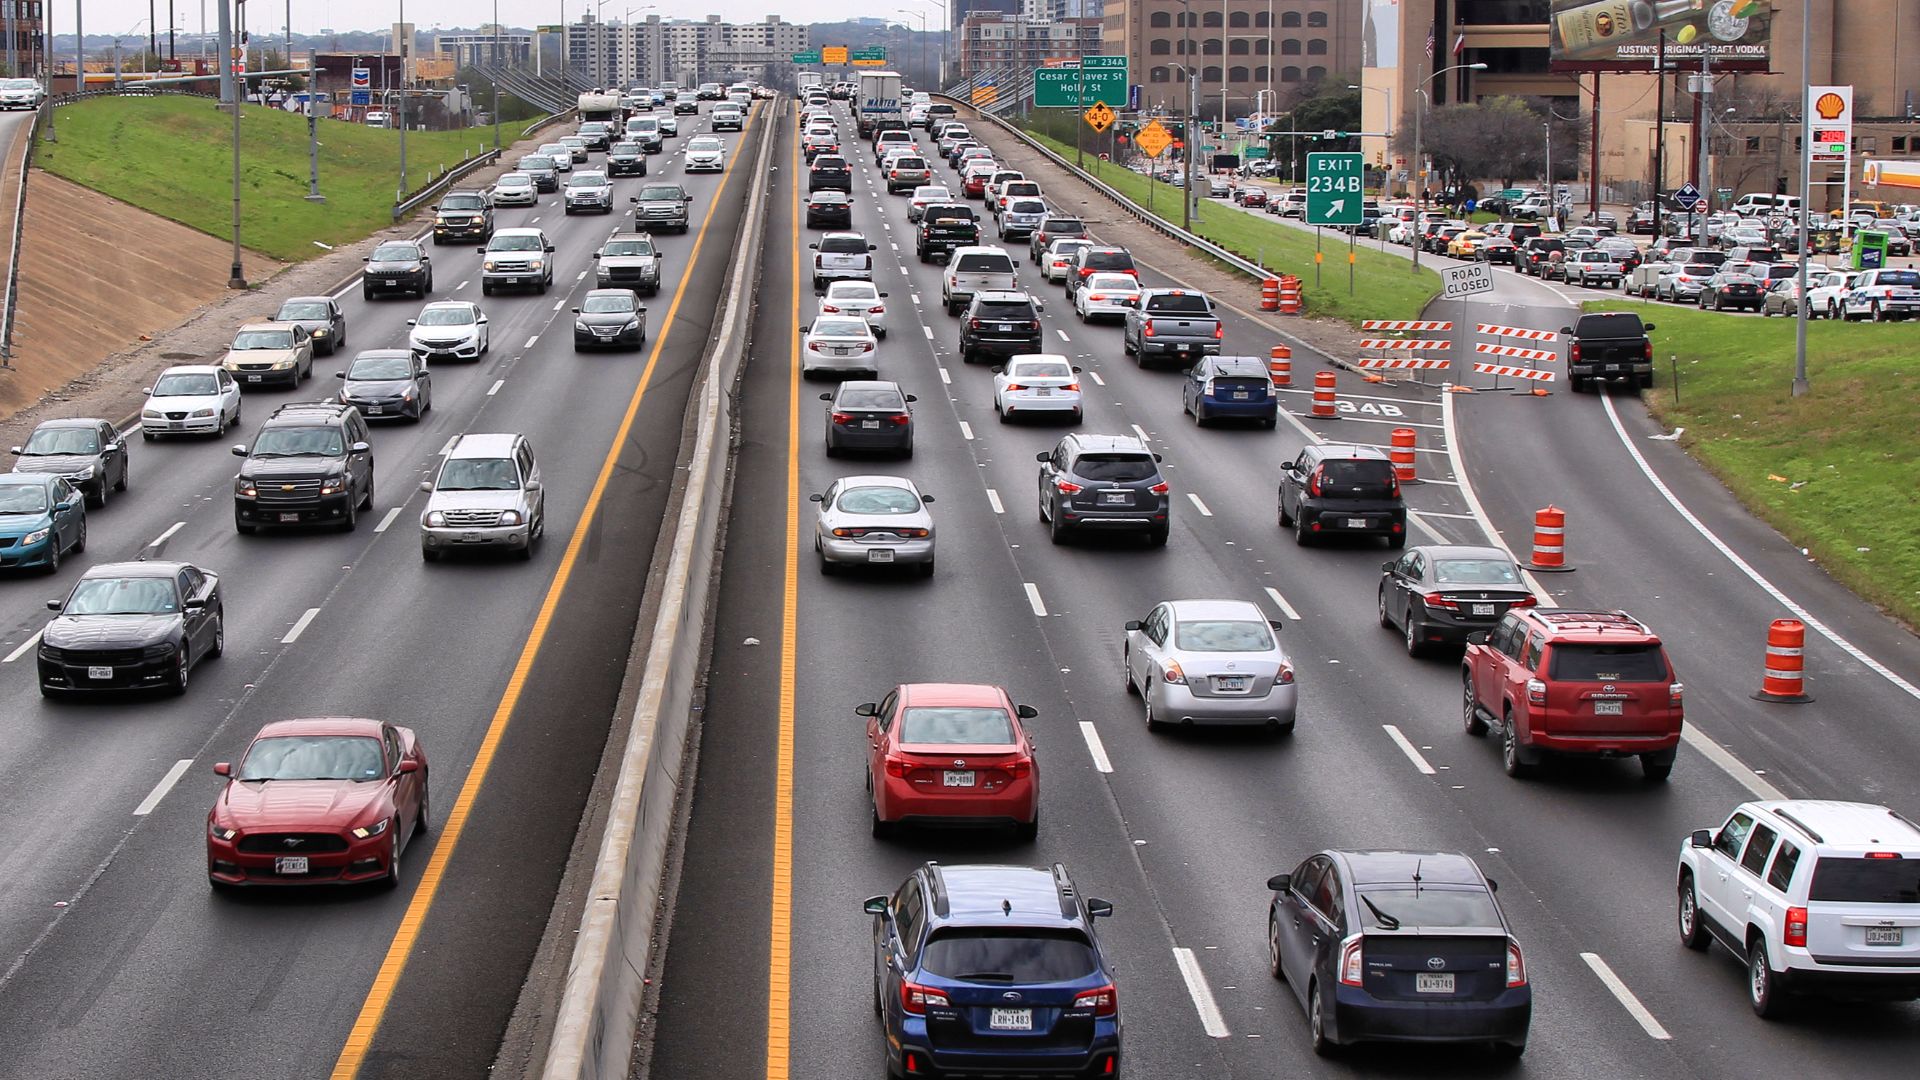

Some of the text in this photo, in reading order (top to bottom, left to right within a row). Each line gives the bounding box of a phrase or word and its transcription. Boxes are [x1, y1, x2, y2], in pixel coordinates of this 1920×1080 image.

[1617, 45, 1658, 54] AUSTIN'S
[1708, 45, 1733, 54] RAFT
[1735, 45, 1766, 54] VODKA
[1039, 72, 1067, 81] Cesar
[1112, 72, 1123, 81] St
[1091, 83, 1102, 91] St
[866, 98, 897, 107] MARTEN
[1318, 159, 1353, 171] EXIT
[1310, 176, 1360, 192] 234B
[1451, 267, 1482, 281] ROAD
[1447, 278, 1490, 294] CLOSED
[1334, 400, 1403, 416] 34B
